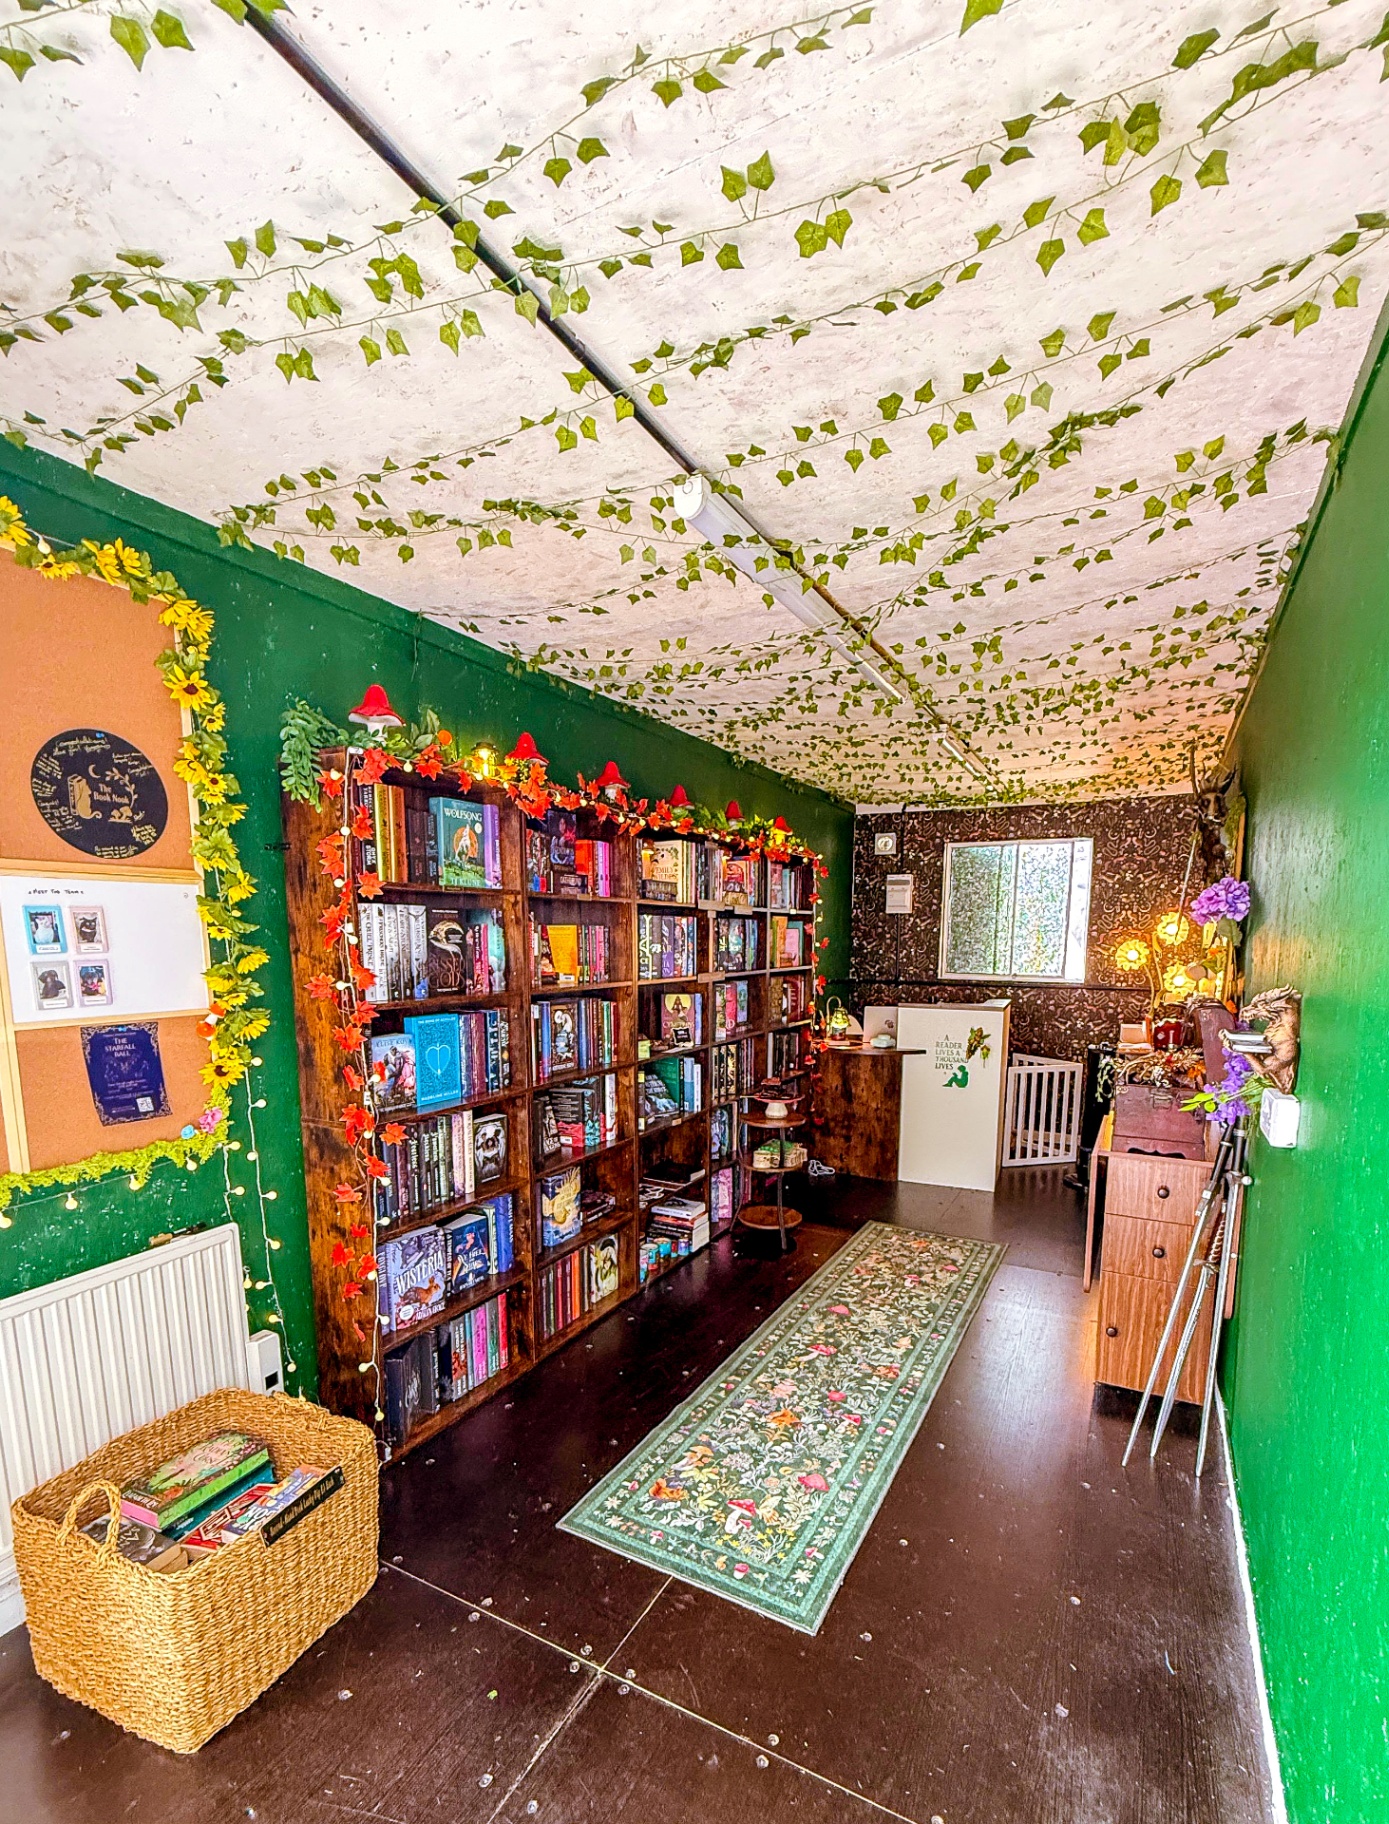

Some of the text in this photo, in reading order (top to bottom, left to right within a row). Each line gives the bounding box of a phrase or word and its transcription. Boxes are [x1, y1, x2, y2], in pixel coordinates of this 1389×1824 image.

[99, 783, 112, 793] The
[93, 791, 129, 804] Book Nook
[444, 807, 482, 821] WOLFSONG
[104, 1043, 136, 1052] STARFALL
[935, 1041, 962, 1049] READER
[935, 1062, 953, 1070] LIVES
[409, 1139, 419, 1169] Fearless
[396, 1250, 443, 1296] WISTERIA
